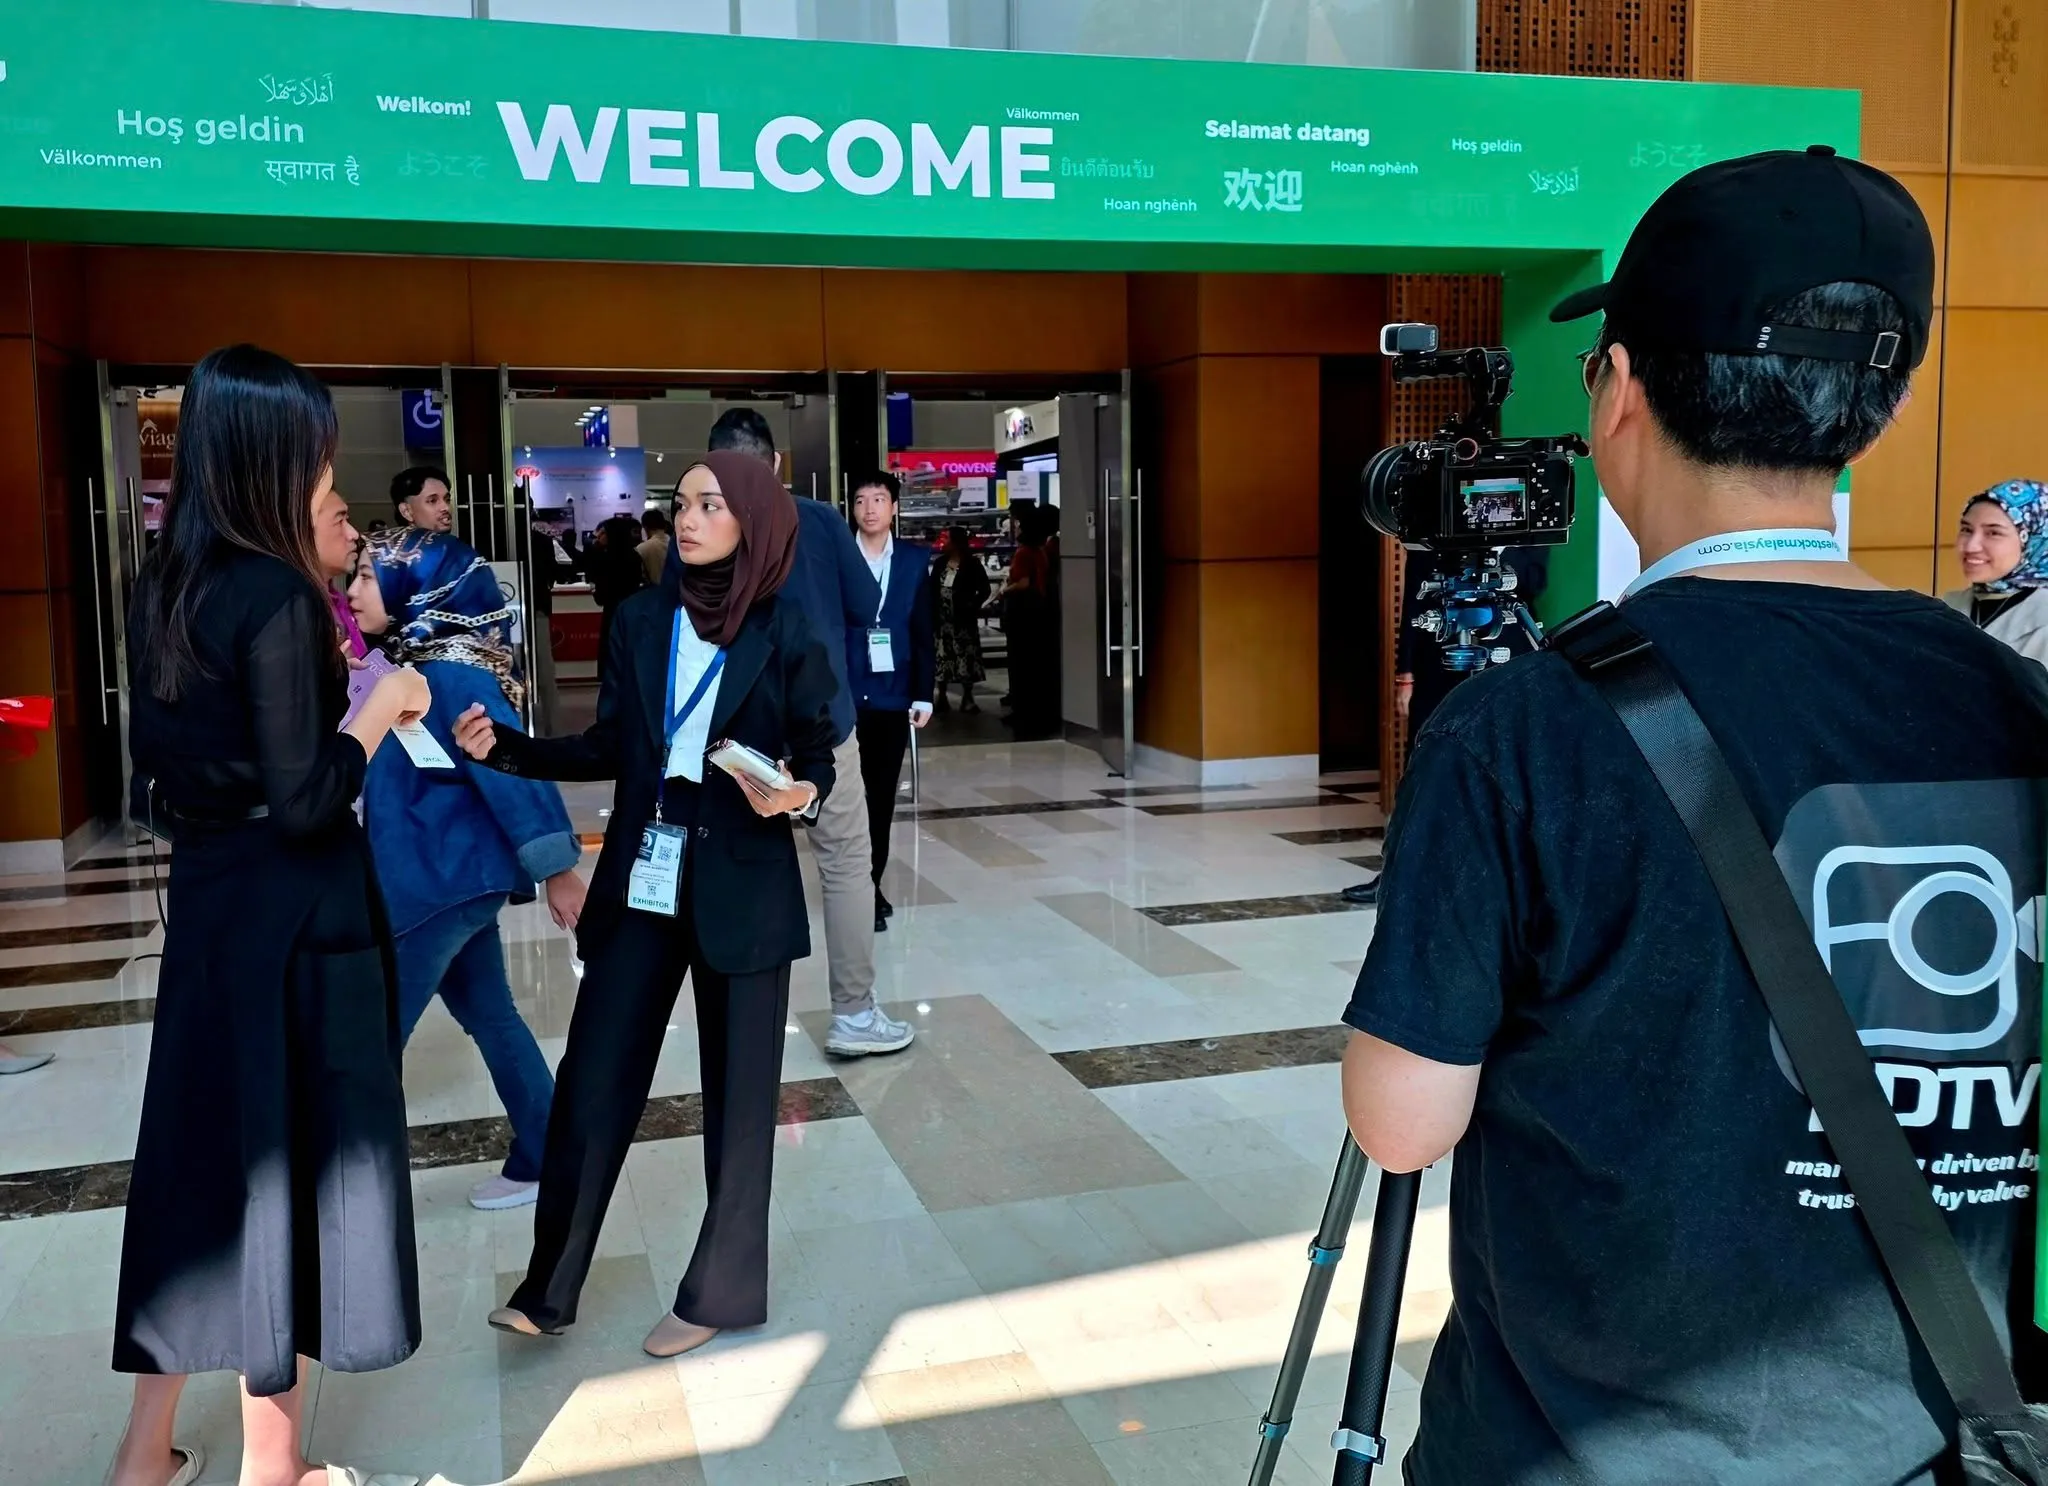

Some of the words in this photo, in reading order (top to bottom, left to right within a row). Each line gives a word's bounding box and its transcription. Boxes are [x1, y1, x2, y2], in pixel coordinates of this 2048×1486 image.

[376, 95, 471, 116] Welkom!
[1006, 107, 1080, 122] Välkommen
[117, 108, 184, 145] Hoş
[195, 114, 304, 145] geldin
[1205, 119, 1292, 140] Selamat
[1297, 122, 1370, 147] datang
[496, 101, 1055, 200] WELCOME
[1452, 138, 1477, 155] Hoş
[1480, 139, 1522, 154] geldin
[39, 148, 162, 169] Välkommen
[1330, 160, 1365, 173] Hoan
[344, 155, 360, 186] है
[1223, 167, 1303, 212] 欢迎
[1104, 198, 1140, 210] Hoan
[941, 462, 997, 474] CONVENE
[632, 896, 670, 909] EXHIBITOR
[1808, 1061, 2042, 1132] DTV
[1931, 1152, 2016, 1175] driven
[1967, 1180, 2031, 1204] value
